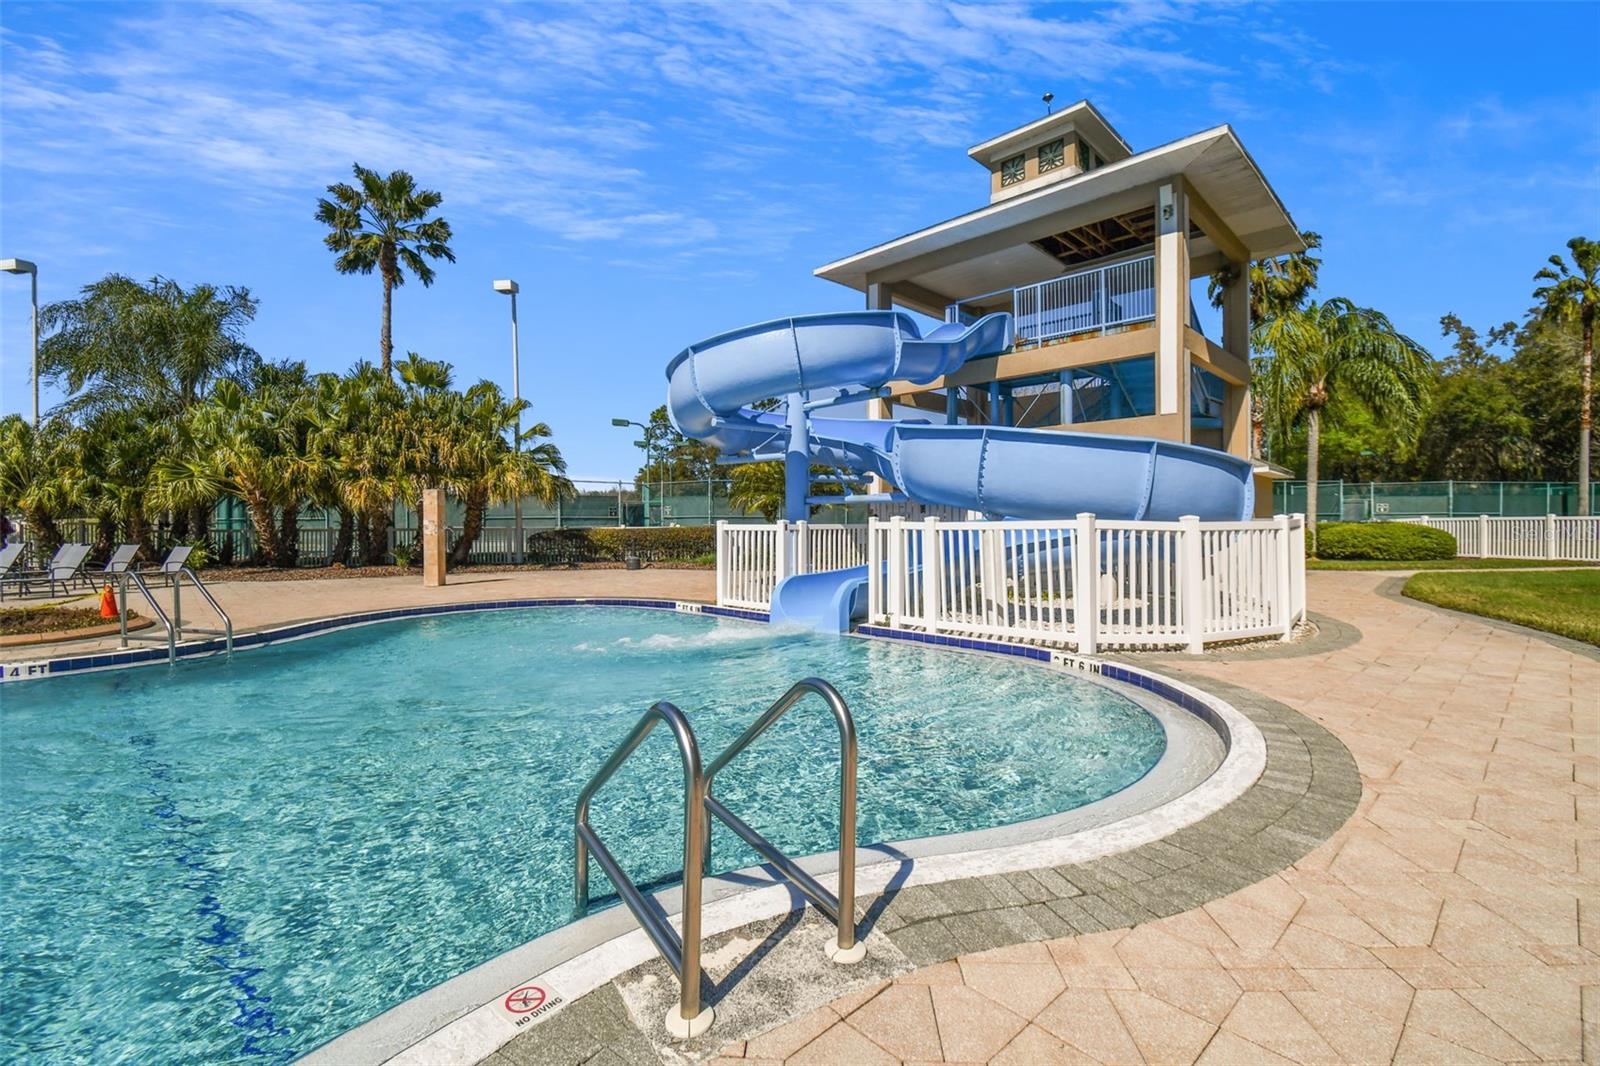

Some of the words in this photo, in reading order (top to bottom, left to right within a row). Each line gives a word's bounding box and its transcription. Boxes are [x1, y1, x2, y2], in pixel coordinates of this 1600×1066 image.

[9, 666, 20, 677] 4
[28, 663, 48, 676] FT
[1063, 657, 1075, 668] FT
[1079, 661, 1085, 671] 6
[1090, 663, 1100, 674] IN
[515, 1015, 531, 1027] NO
[530, 996, 563, 1018] DIVING
